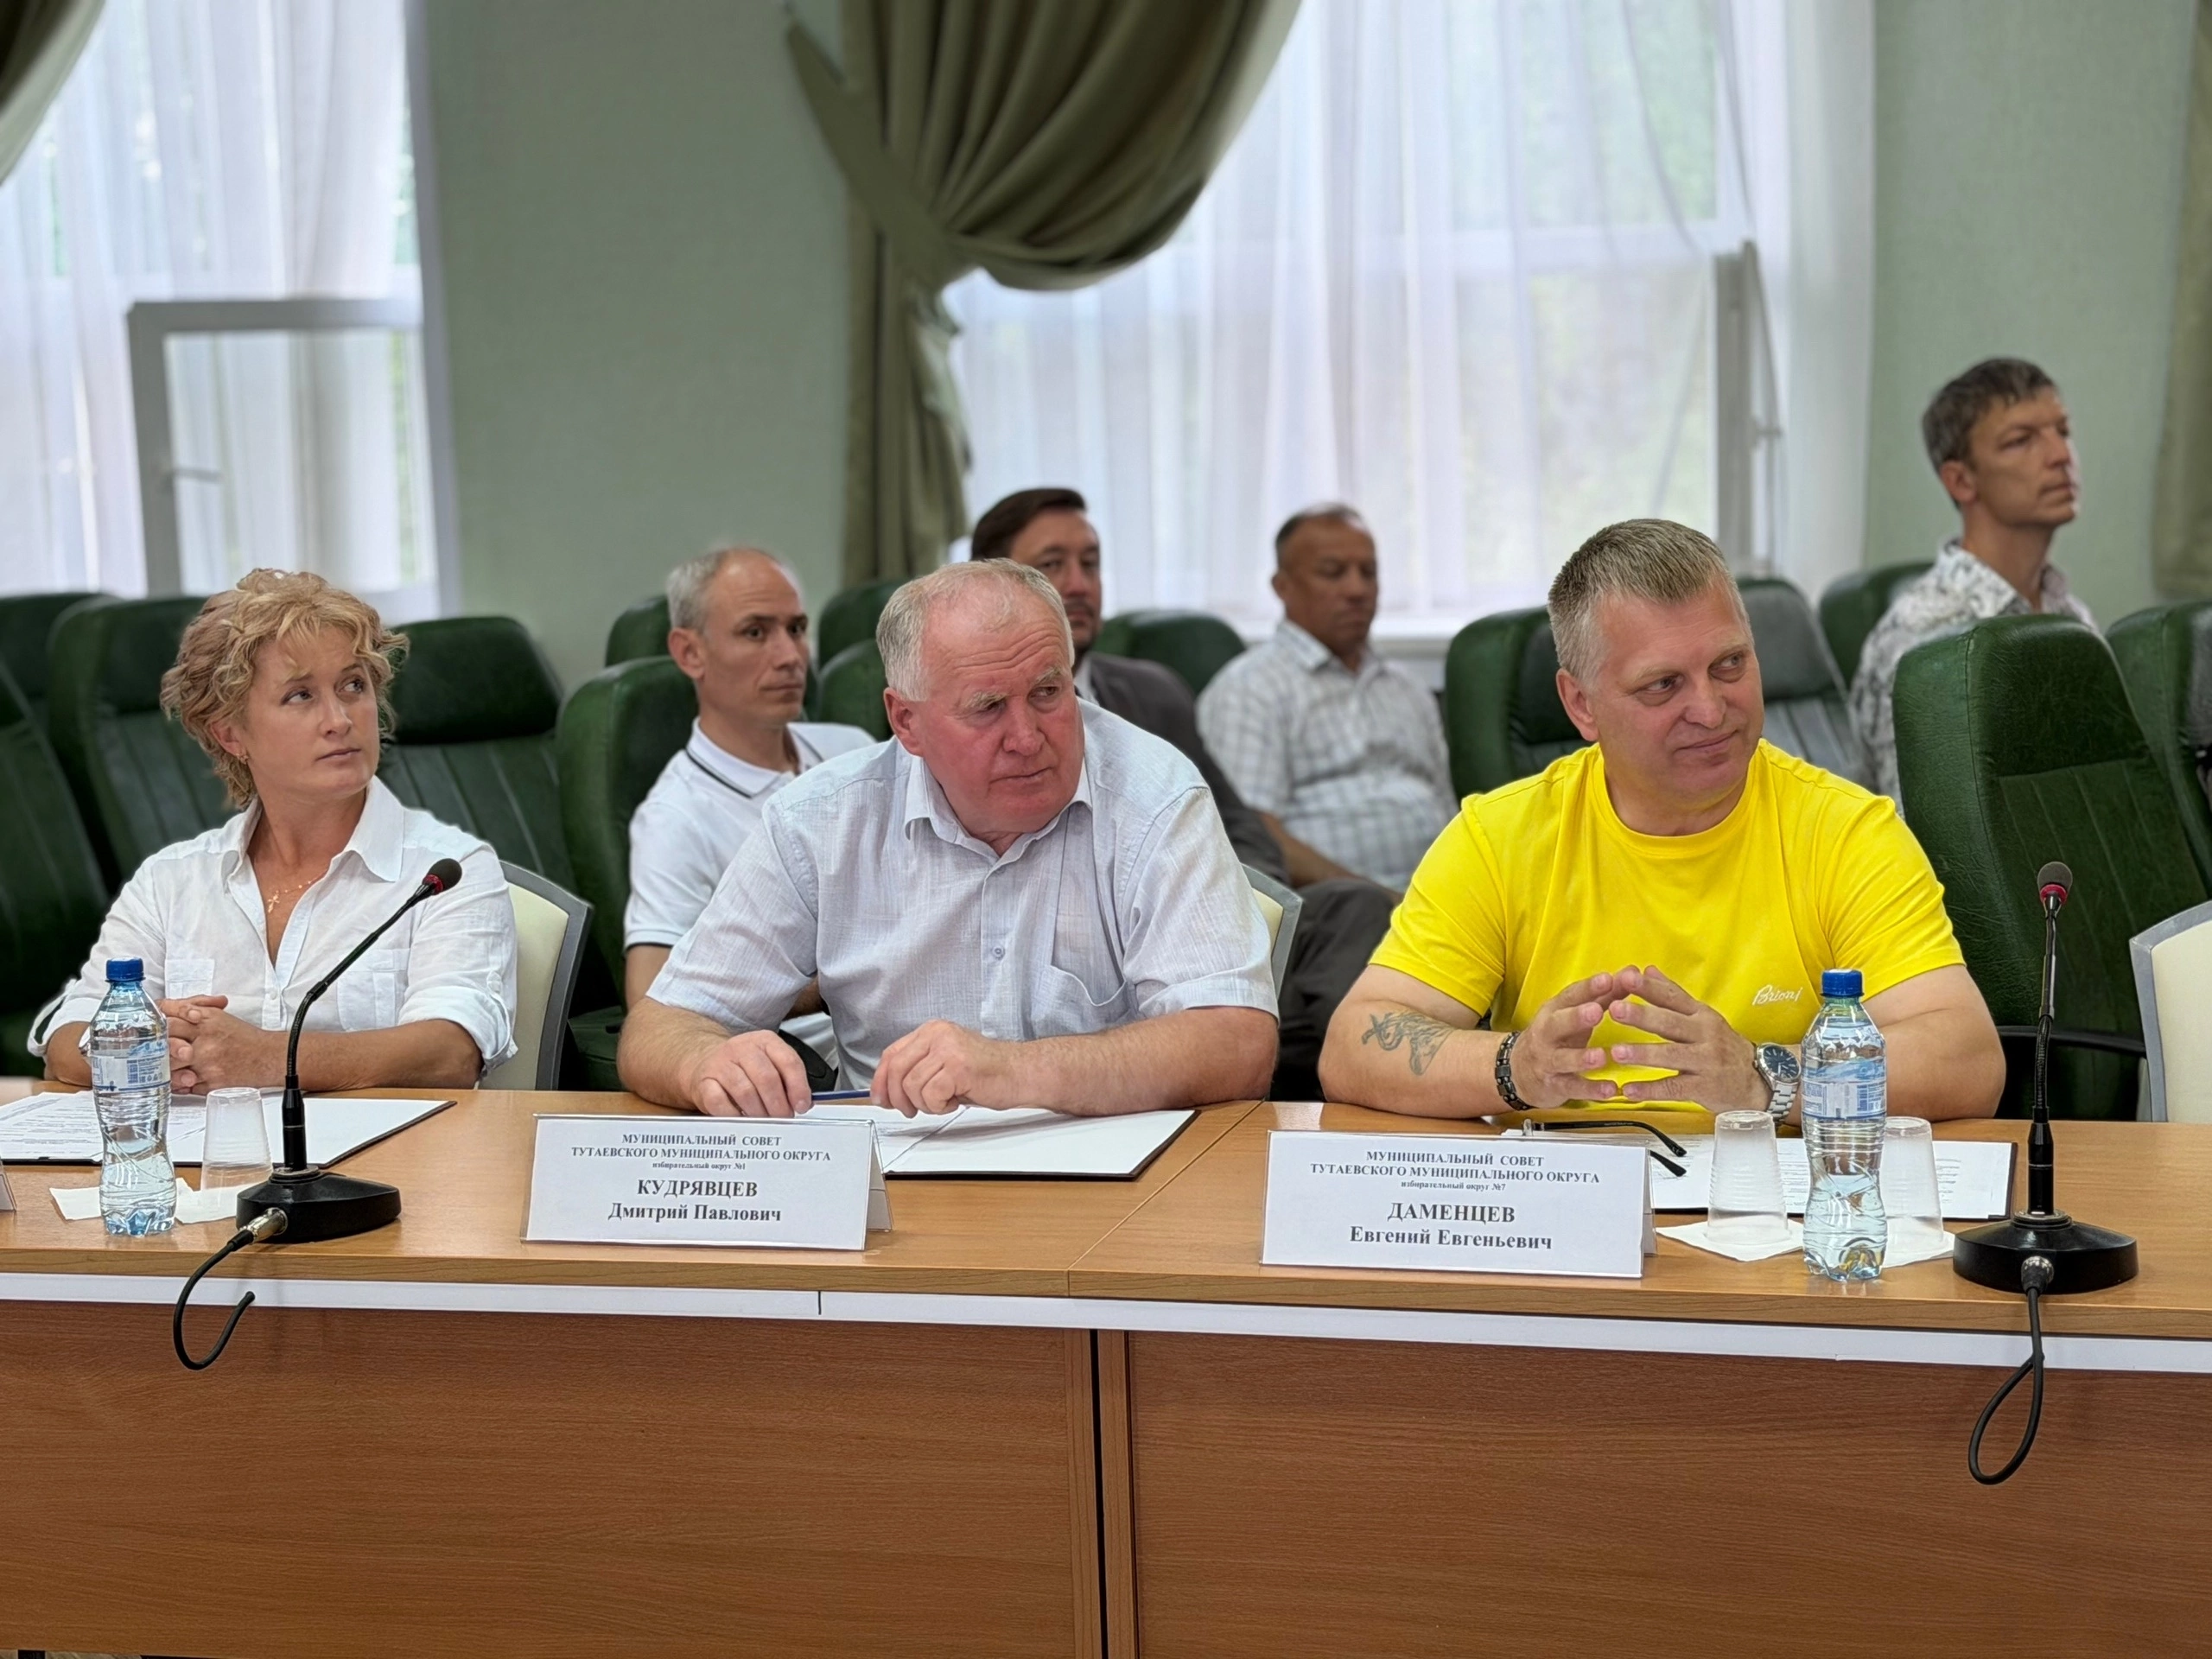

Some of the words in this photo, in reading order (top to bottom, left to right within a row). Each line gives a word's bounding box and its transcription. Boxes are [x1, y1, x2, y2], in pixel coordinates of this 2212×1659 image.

[1752, 984, 1802, 1006] Brioni
[621, 1133, 737, 1147] МУНИЦИПАЛЬНЫЙ
[742, 1135, 782, 1147] СОВЕТ
[571, 1147, 658, 1160] ТУТАЕВСКОГО
[660, 1147, 780, 1161] МУНИЦИПАЛЬНОГО
[783, 1150, 831, 1162] ОКРУГА
[1366, 1150, 1494, 1166] МУНИЦИПАЛЬНЫЙ
[1500, 1154, 1545, 1167] СОВЕТ
[652, 1161, 709, 1170] избирательный
[711, 1163, 732, 1172] округ
[1311, 1163, 1407, 1177] ТУТАЕВСКОГО
[1409, 1167, 1543, 1182] МУНИЦИПАЛЬНОГО
[1547, 1171, 1600, 1184] ОКРУГА
[637, 1179, 759, 1198] КУДРЯВЦЕВ
[1401, 1180, 1465, 1191] избирательный
[1465, 1183, 1490, 1192] округ
[608, 1203, 688, 1223] Дмитрий
[694, 1205, 781, 1222] Павлович
[1387, 1202, 1516, 1224] ДАМЕНЦЕВ
[1350, 1225, 1431, 1245] Евгений
[1437, 1229, 1552, 1250] Евгеньевич
